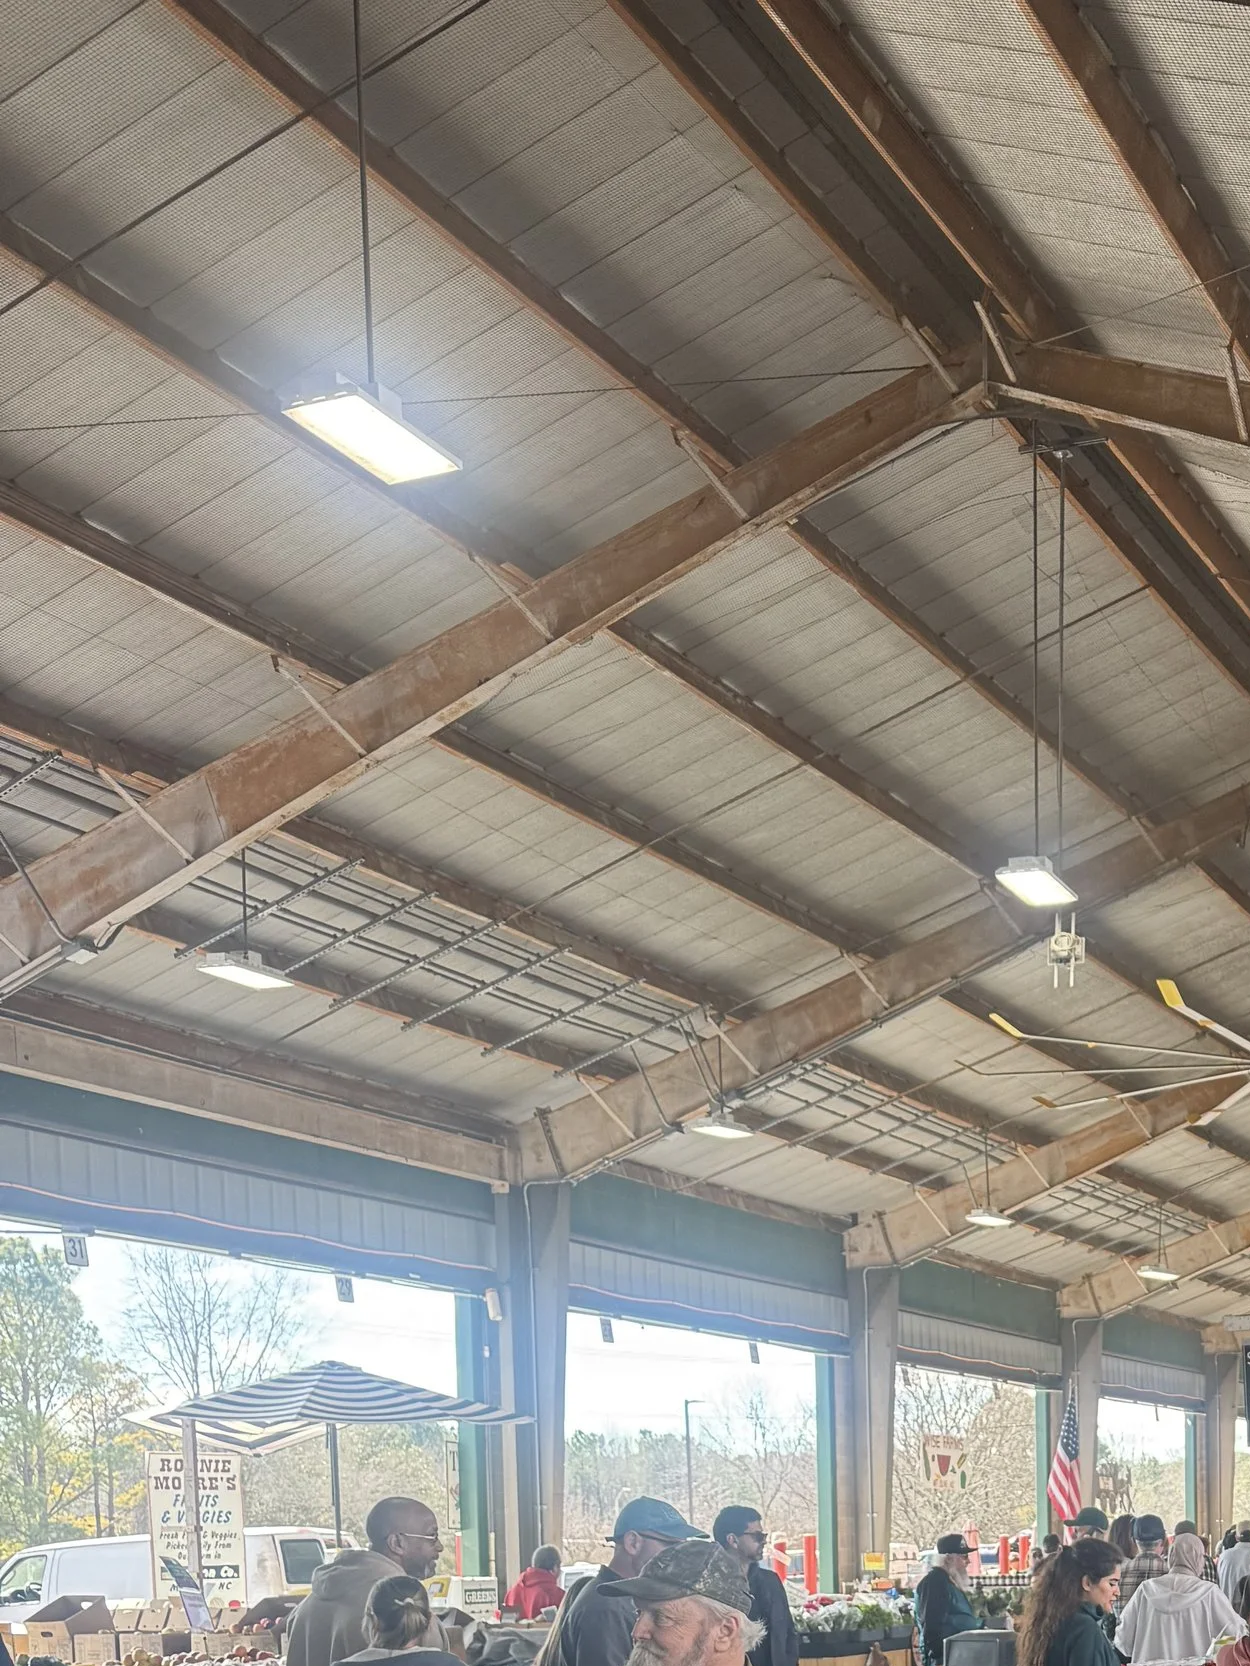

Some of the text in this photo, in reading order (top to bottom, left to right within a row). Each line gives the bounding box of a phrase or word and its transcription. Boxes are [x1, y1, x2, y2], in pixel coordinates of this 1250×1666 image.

[159, 1458, 232, 1473] RONIE
[154, 1475, 237, 1491] MORE'S
[161, 1510, 232, 1524] & VGIES
[214, 1539, 232, 1549] From
[218, 1580, 232, 1590] NC
